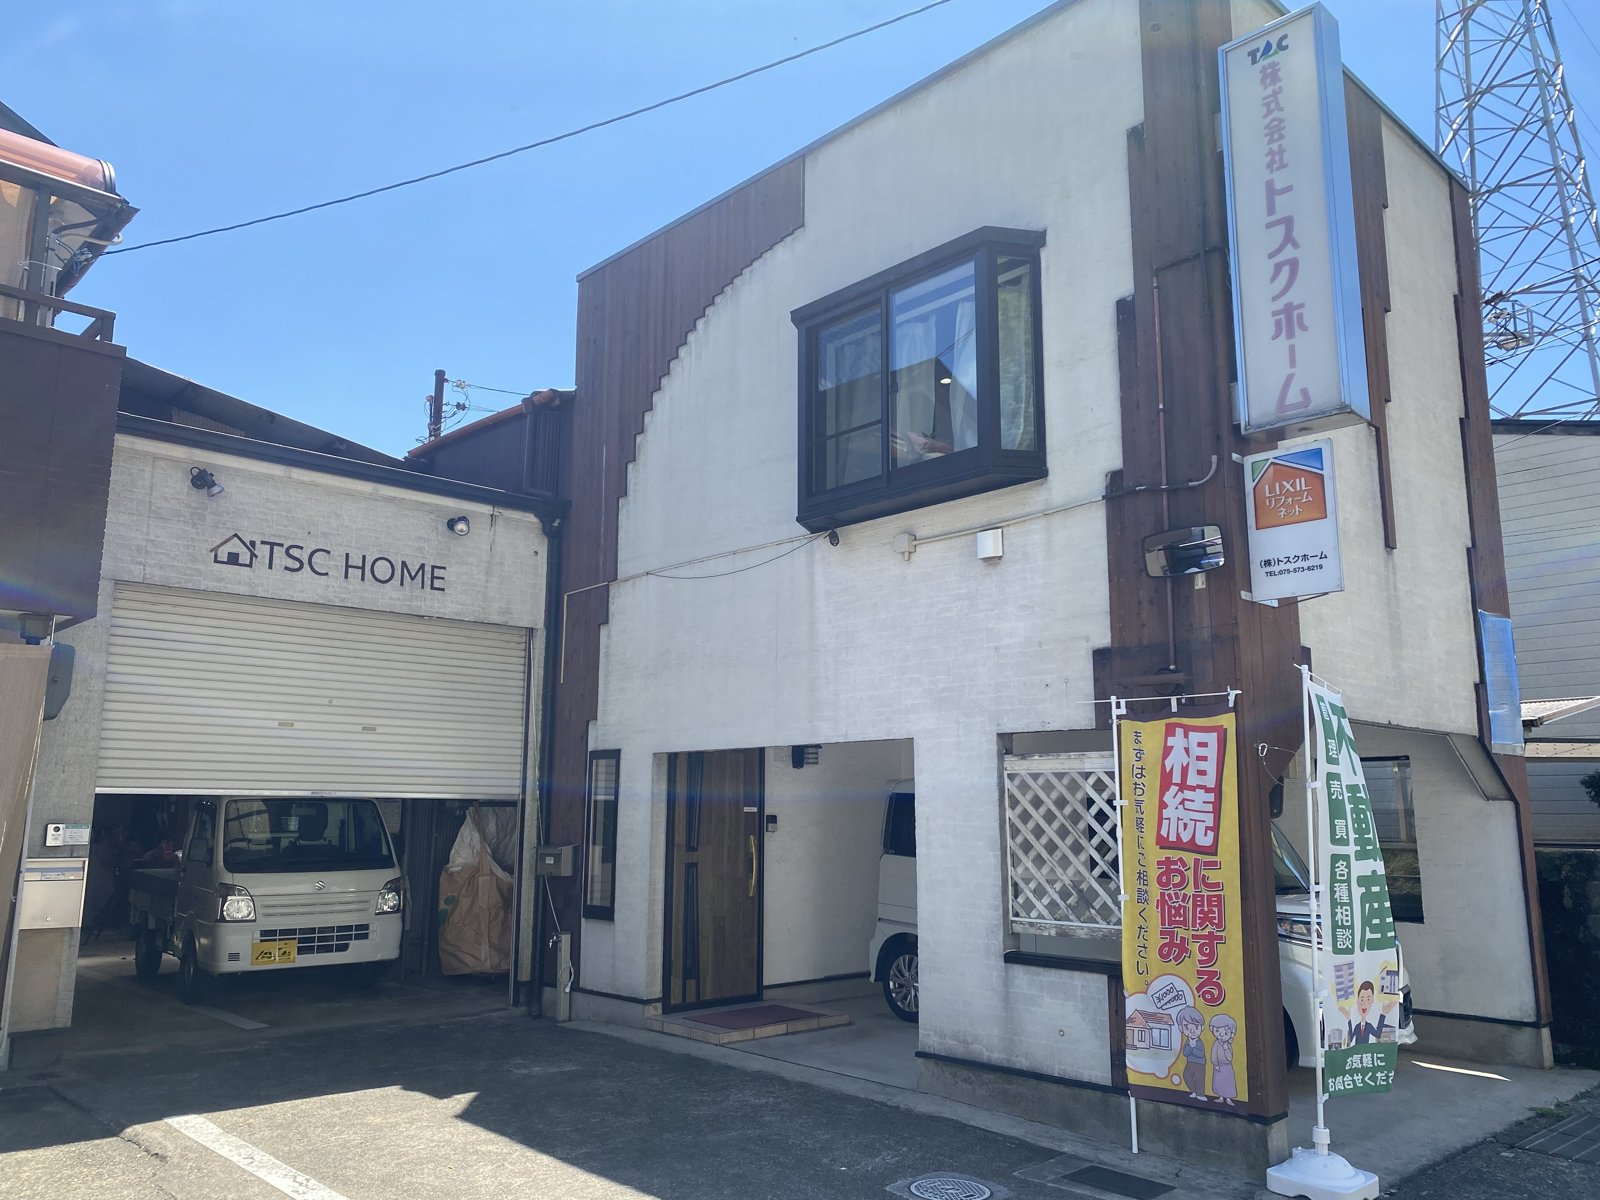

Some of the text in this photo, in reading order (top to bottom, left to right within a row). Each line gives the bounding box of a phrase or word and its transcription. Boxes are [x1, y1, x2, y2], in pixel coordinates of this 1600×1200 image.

[1259, 60, 1312, 414] 株式会社トスクホーム
[1265, 477, 1312, 497] LIXIL
[1266, 491, 1313, 510] リフォーム
[1279, 504, 1303, 519] ネット
[260, 540, 447, 592] TSC HOME
[1160, 727, 1218, 847] 相続
[1131, 730, 1149, 986] まずはお気軽にご相談ください。
[1155, 856, 1190, 966] お悩み
[1190, 857, 1226, 1006] に関する
[1333, 860, 1352, 949] 各種相談
[1345, 1053, 1386, 1070] お気軽に
